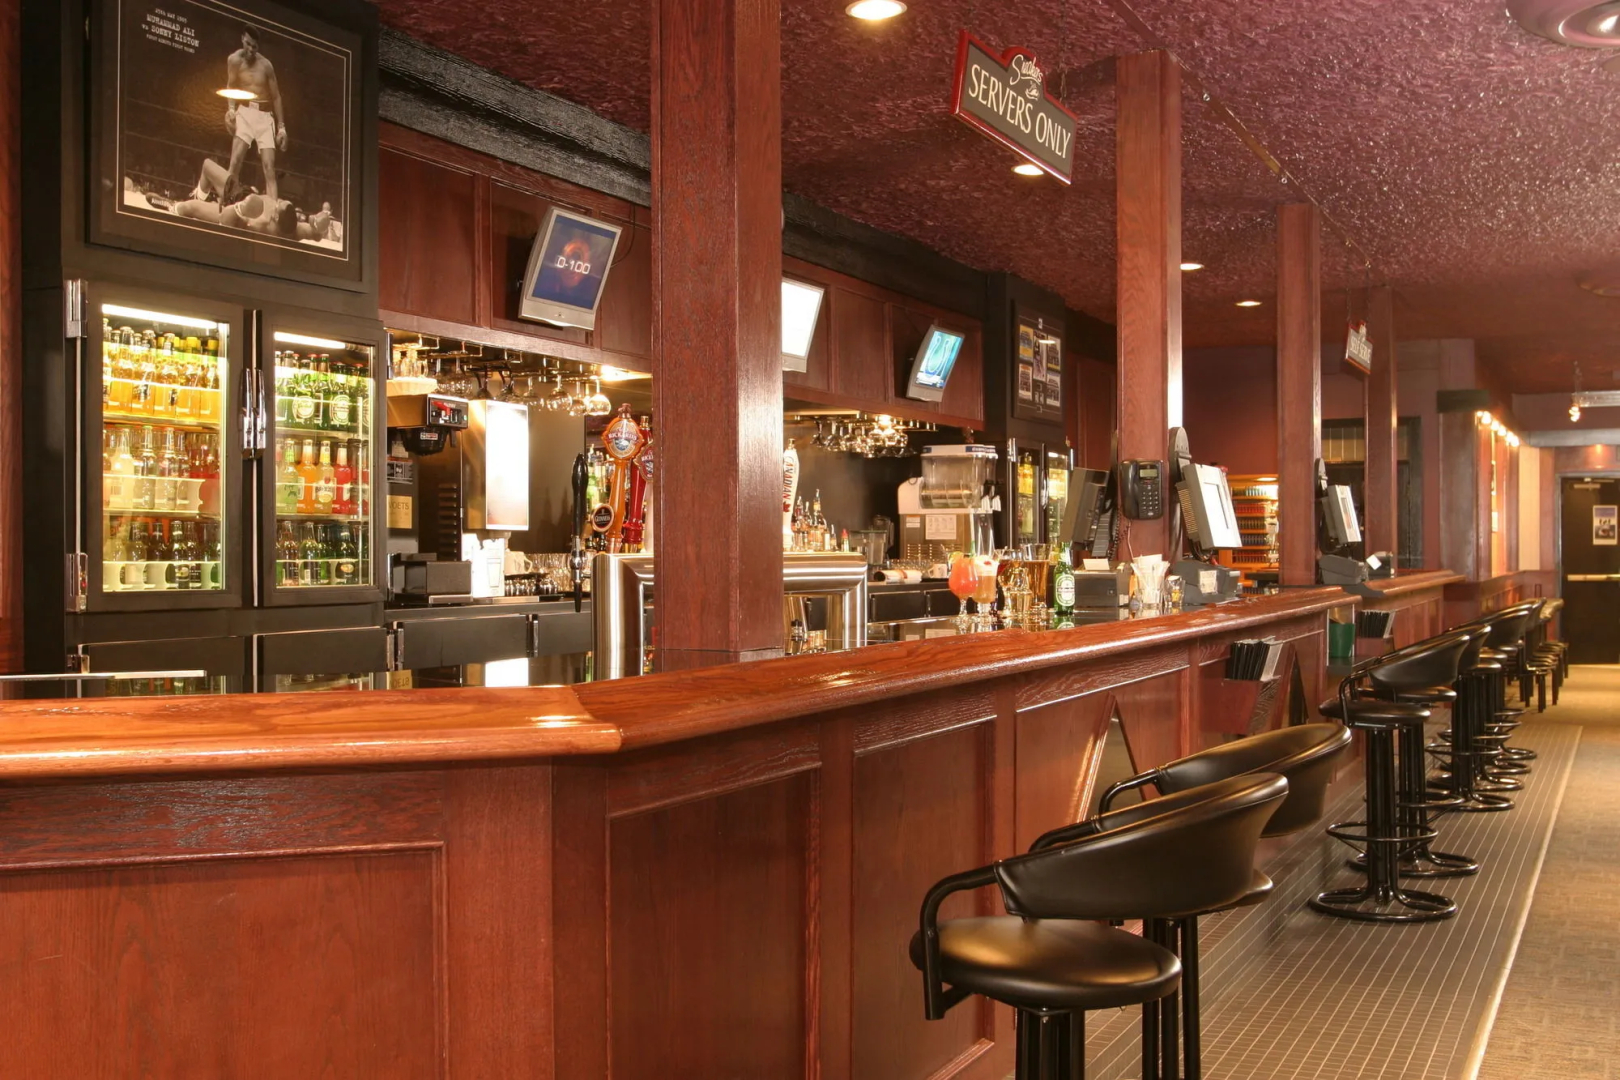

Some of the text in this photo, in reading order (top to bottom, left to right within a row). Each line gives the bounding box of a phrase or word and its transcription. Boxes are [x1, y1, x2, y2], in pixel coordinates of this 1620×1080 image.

[146, 14, 194, 36] MUHAMMAD ALI
[151, 25, 172, 38] SONNY
[174, 32, 200, 48] LISTON
[968, 63, 1071, 159] SERVERS ONLY
[555, 255, 591, 275] D-100
[783, 455, 794, 500] CANADIAN
